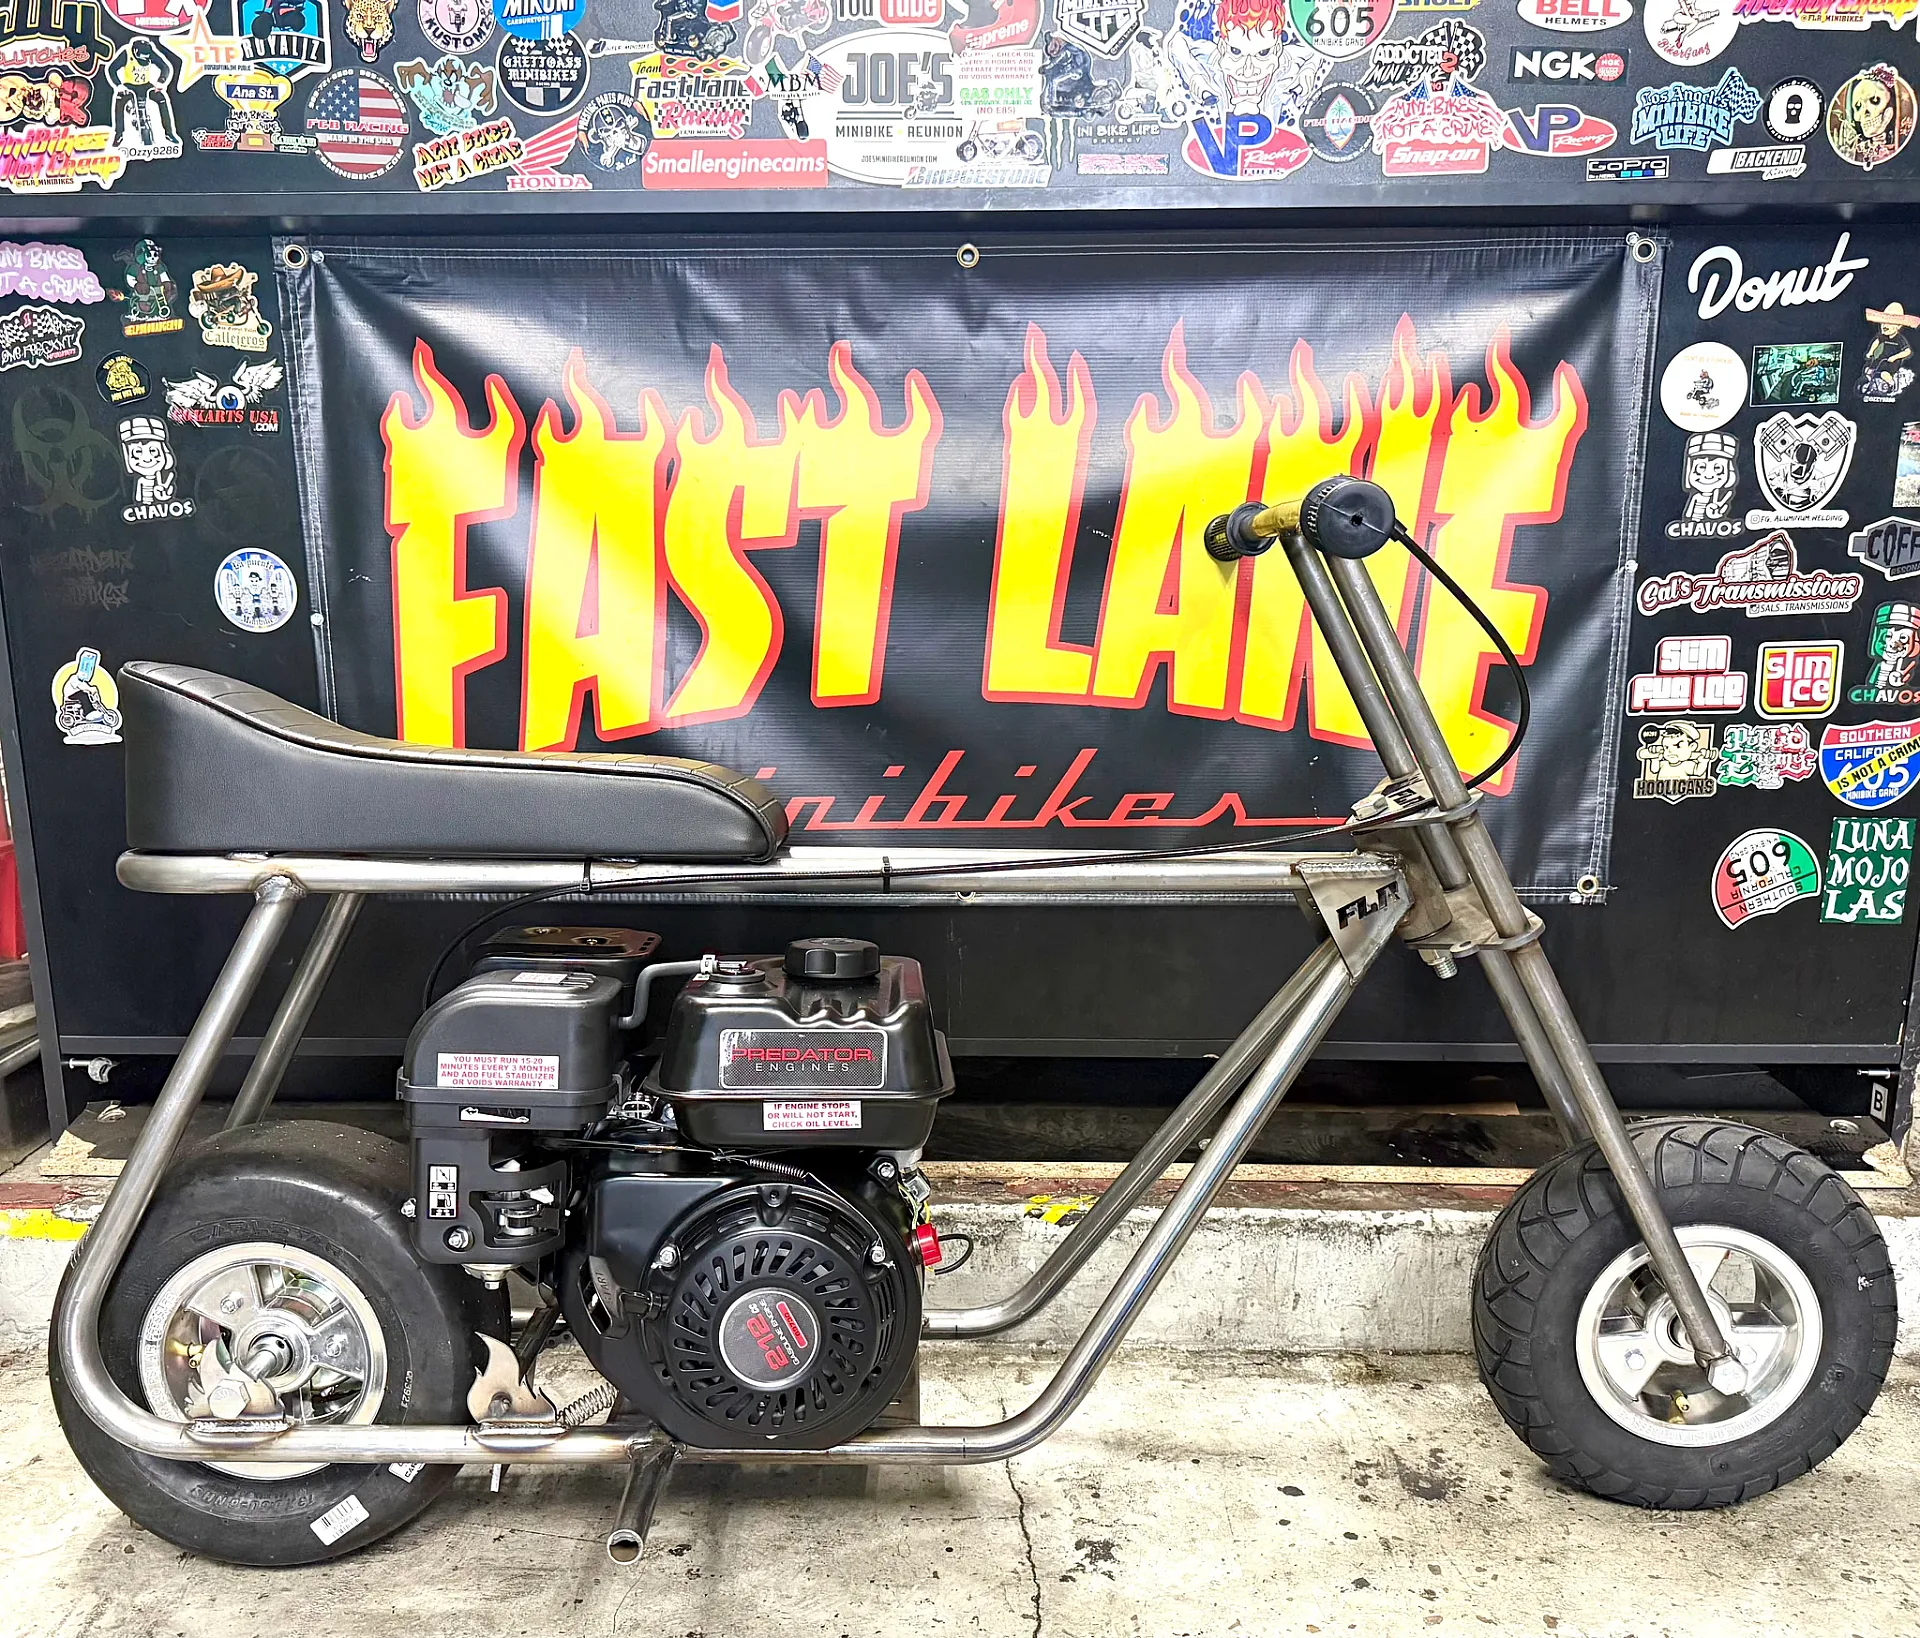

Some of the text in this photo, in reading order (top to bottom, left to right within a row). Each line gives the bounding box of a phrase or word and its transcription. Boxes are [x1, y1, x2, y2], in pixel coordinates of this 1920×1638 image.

[1306, 7, 1375, 37] 605
[1545, 17, 1607, 25] HELMETS
[964, 18, 1030, 50] Supreme
[508, 69, 579, 82] MINIBIKES
[1513, 50, 1596, 81] NGK
[765, 73, 825, 91] MBM
[842, 52, 954, 106] JOE'S
[232, 86, 275, 99] Ana St.
[595, 92, 617, 107] PARTS
[616, 92, 634, 108] PLUS
[960, 87, 1033, 100] GAS ONLY
[1641, 85, 1729, 109] Los Angeles
[345, 121, 409, 134] RACING
[661, 99, 747, 139] Racing
[1638, 100, 1731, 137] MINIBIKE
[462, 121, 514, 152] BIKES
[836, 125, 963, 138] MINIBIKE REUNION
[1096, 124, 1128, 136] BIKE
[1508, 106, 1581, 152] VP
[1660, 125, 1709, 147] LIFE
[417, 141, 524, 188] NOT A CRIME
[644, 149, 826, 179] Smallenginecams
[1389, 146, 1481, 166] Snap-on
[1588, 160, 1666, 171] GoPro
[1736, 149, 1800, 168] BACKEND
[509, 176, 590, 189] HONDA
[1687, 231, 1870, 320] Donut
[249, 409, 279, 425] USA
[253, 423, 279, 432] .COM
[123, 501, 194, 522] CHAVOS
[1667, 521, 1742, 537] CHAVOS
[383, 314, 1589, 796] FAST LANE
[1693, 573, 1859, 607] Transmissions
[1839, 726, 1911, 743] SOUTHERN
[1836, 736, 1920, 790] IS NOT A CRIM
[1636, 778, 1715, 797] HOOLIGANS
[1845, 789, 1877, 800] MINIBIKE
[1835, 818, 1912, 852] LUNA
[1827, 854, 1910, 887] MOJO
[1738, 882, 1803, 914] SOUTHERN
[1825, 889, 1906, 922] LAS
[473, 1056, 498, 1064] MUST
[731, 1047, 876, 1062] PREDATOR
[505, 1072, 554, 1080] STABILIZER
[755, 1062, 850, 1072] ENGINES
[495, 1079, 543, 1087] WARRANTY
[1873, 1089, 1884, 1111] B
[827, 1111, 858, 1119] START,
[746, 1313, 790, 1371] 212
[759, 1299, 800, 1366] GASOLINE ENGINE
